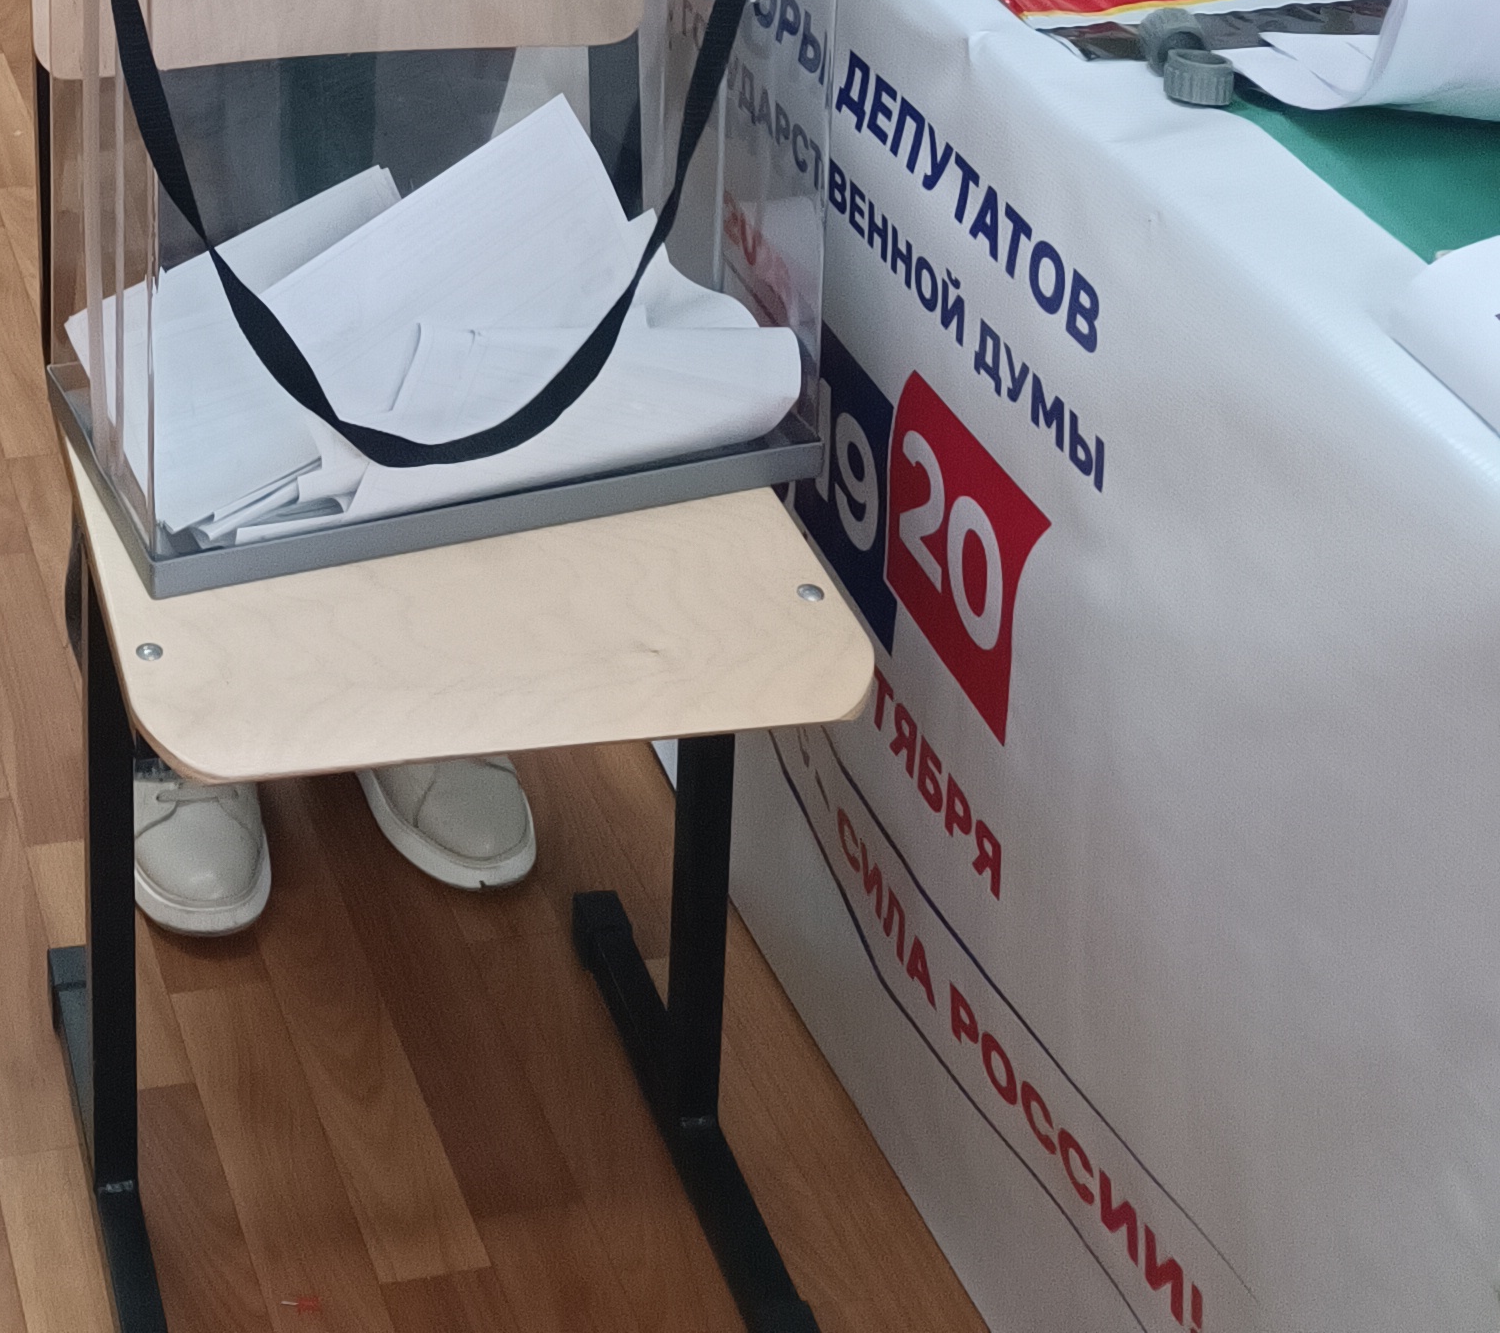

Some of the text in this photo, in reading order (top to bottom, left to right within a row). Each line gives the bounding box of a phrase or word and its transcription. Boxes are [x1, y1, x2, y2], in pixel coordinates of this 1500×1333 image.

[835, 49, 1101, 354] ДЕПУТАТОВ
[973, 317, 1105, 493] ДУМЫ
[899, 429, 1004, 651] 20
[873, 663, 1002, 902] ТЯБРЯ
[836, 806, 1204, 1333] СИЛА РОССИИ!
